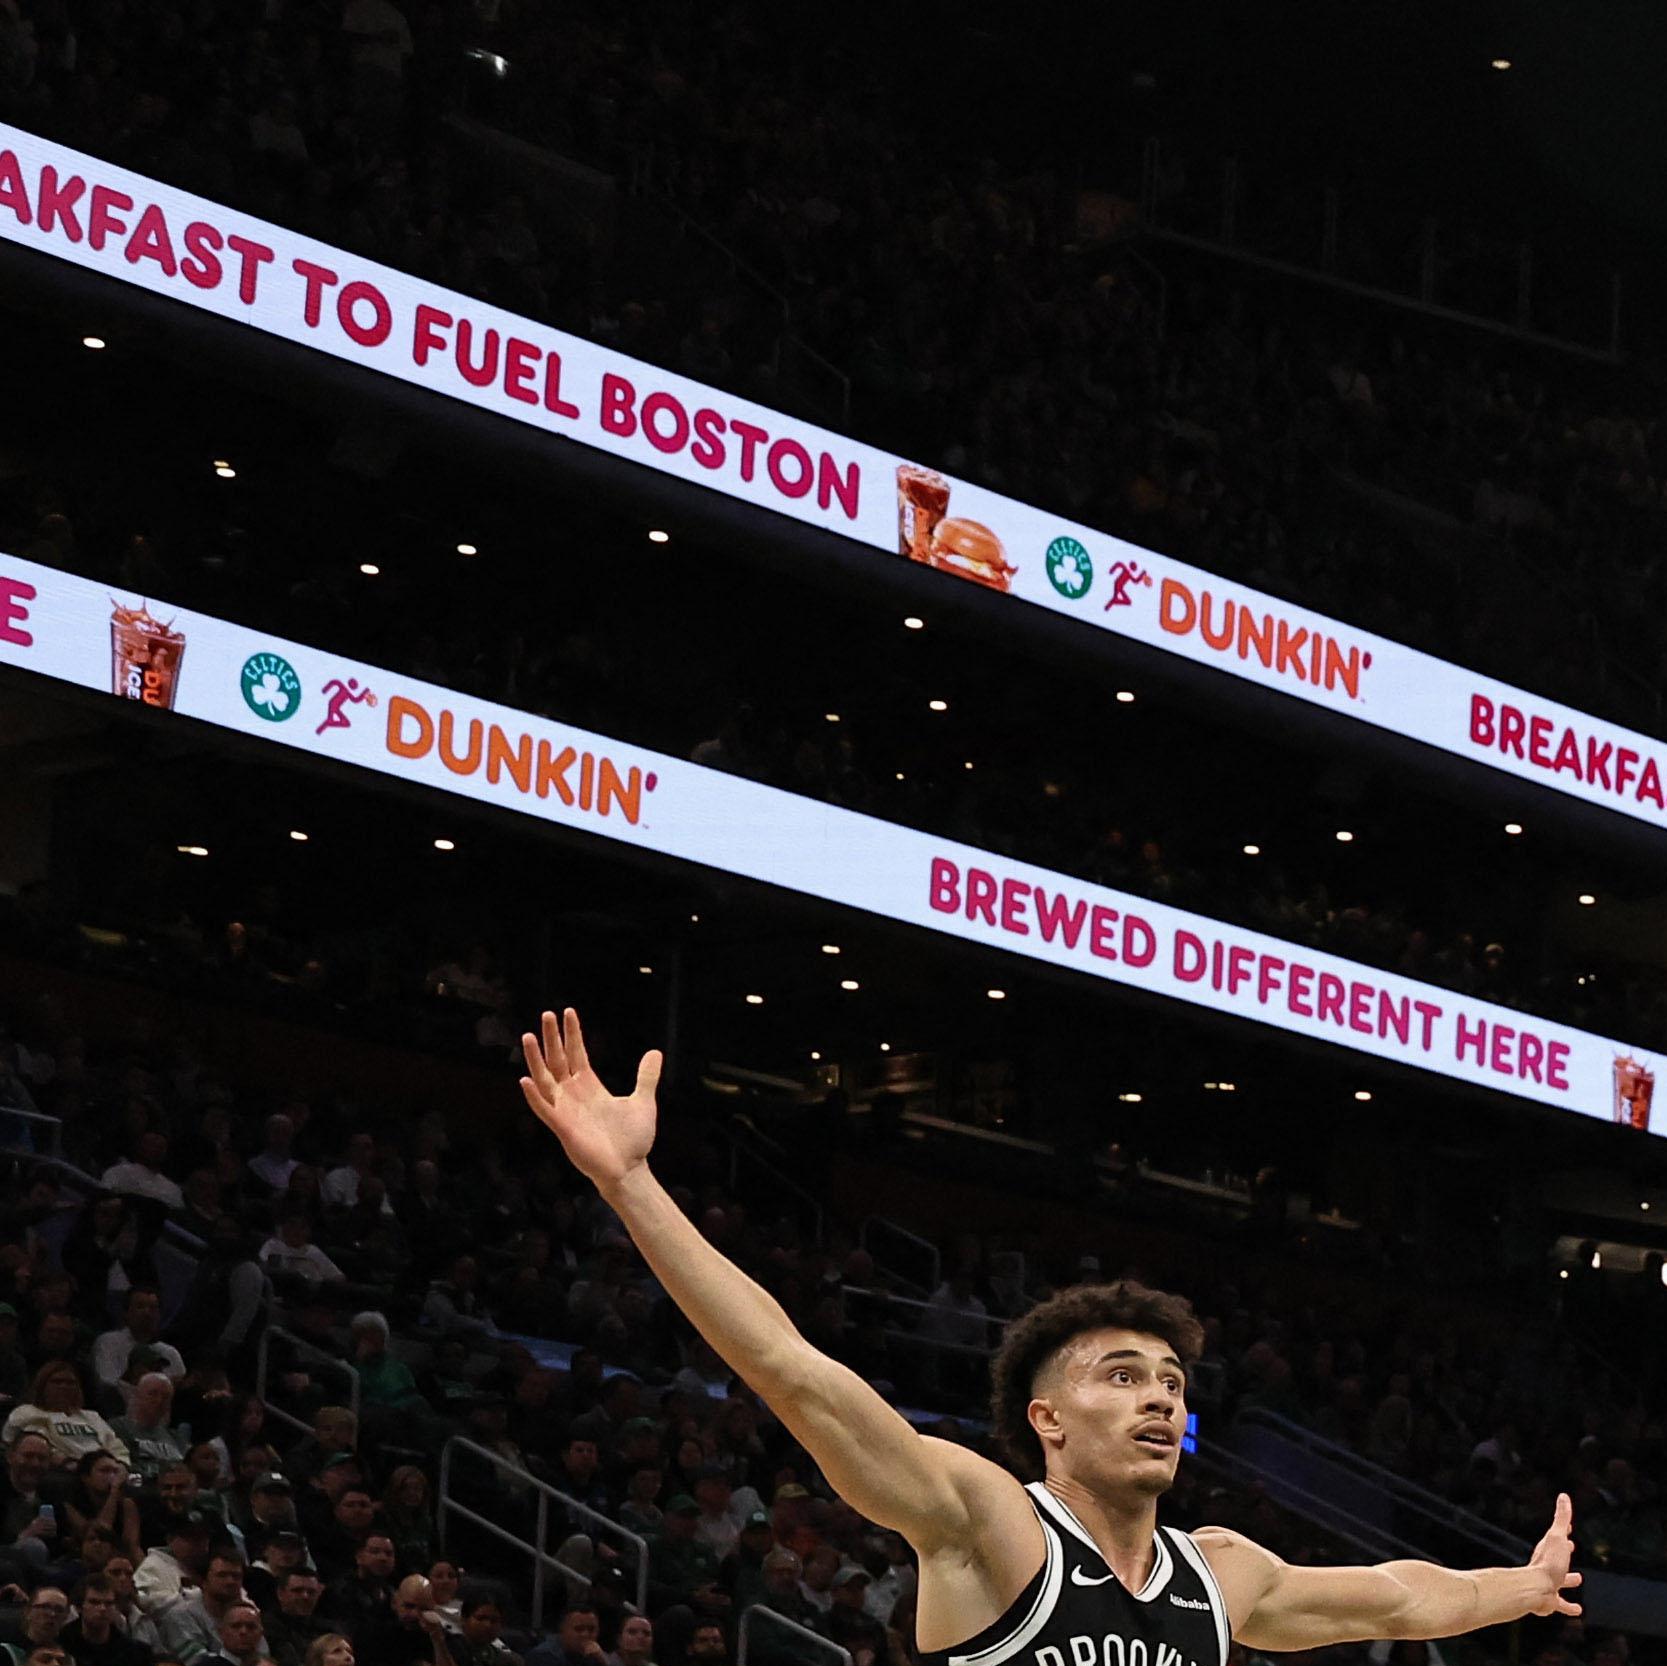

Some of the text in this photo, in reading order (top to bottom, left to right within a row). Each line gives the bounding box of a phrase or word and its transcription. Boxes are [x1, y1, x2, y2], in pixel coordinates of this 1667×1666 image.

[293, 258, 393, 348] TO
[413, 304, 581, 420] FUEL
[600, 373, 861, 520] BOSTON
[244, 655, 299, 691] CELTICS
[1159, 578, 1373, 699] DUNKIN'
[387, 696, 657, 825] DUNKIN'
[930, 857, 1571, 1090] BREWED DIFFERENT HERE
